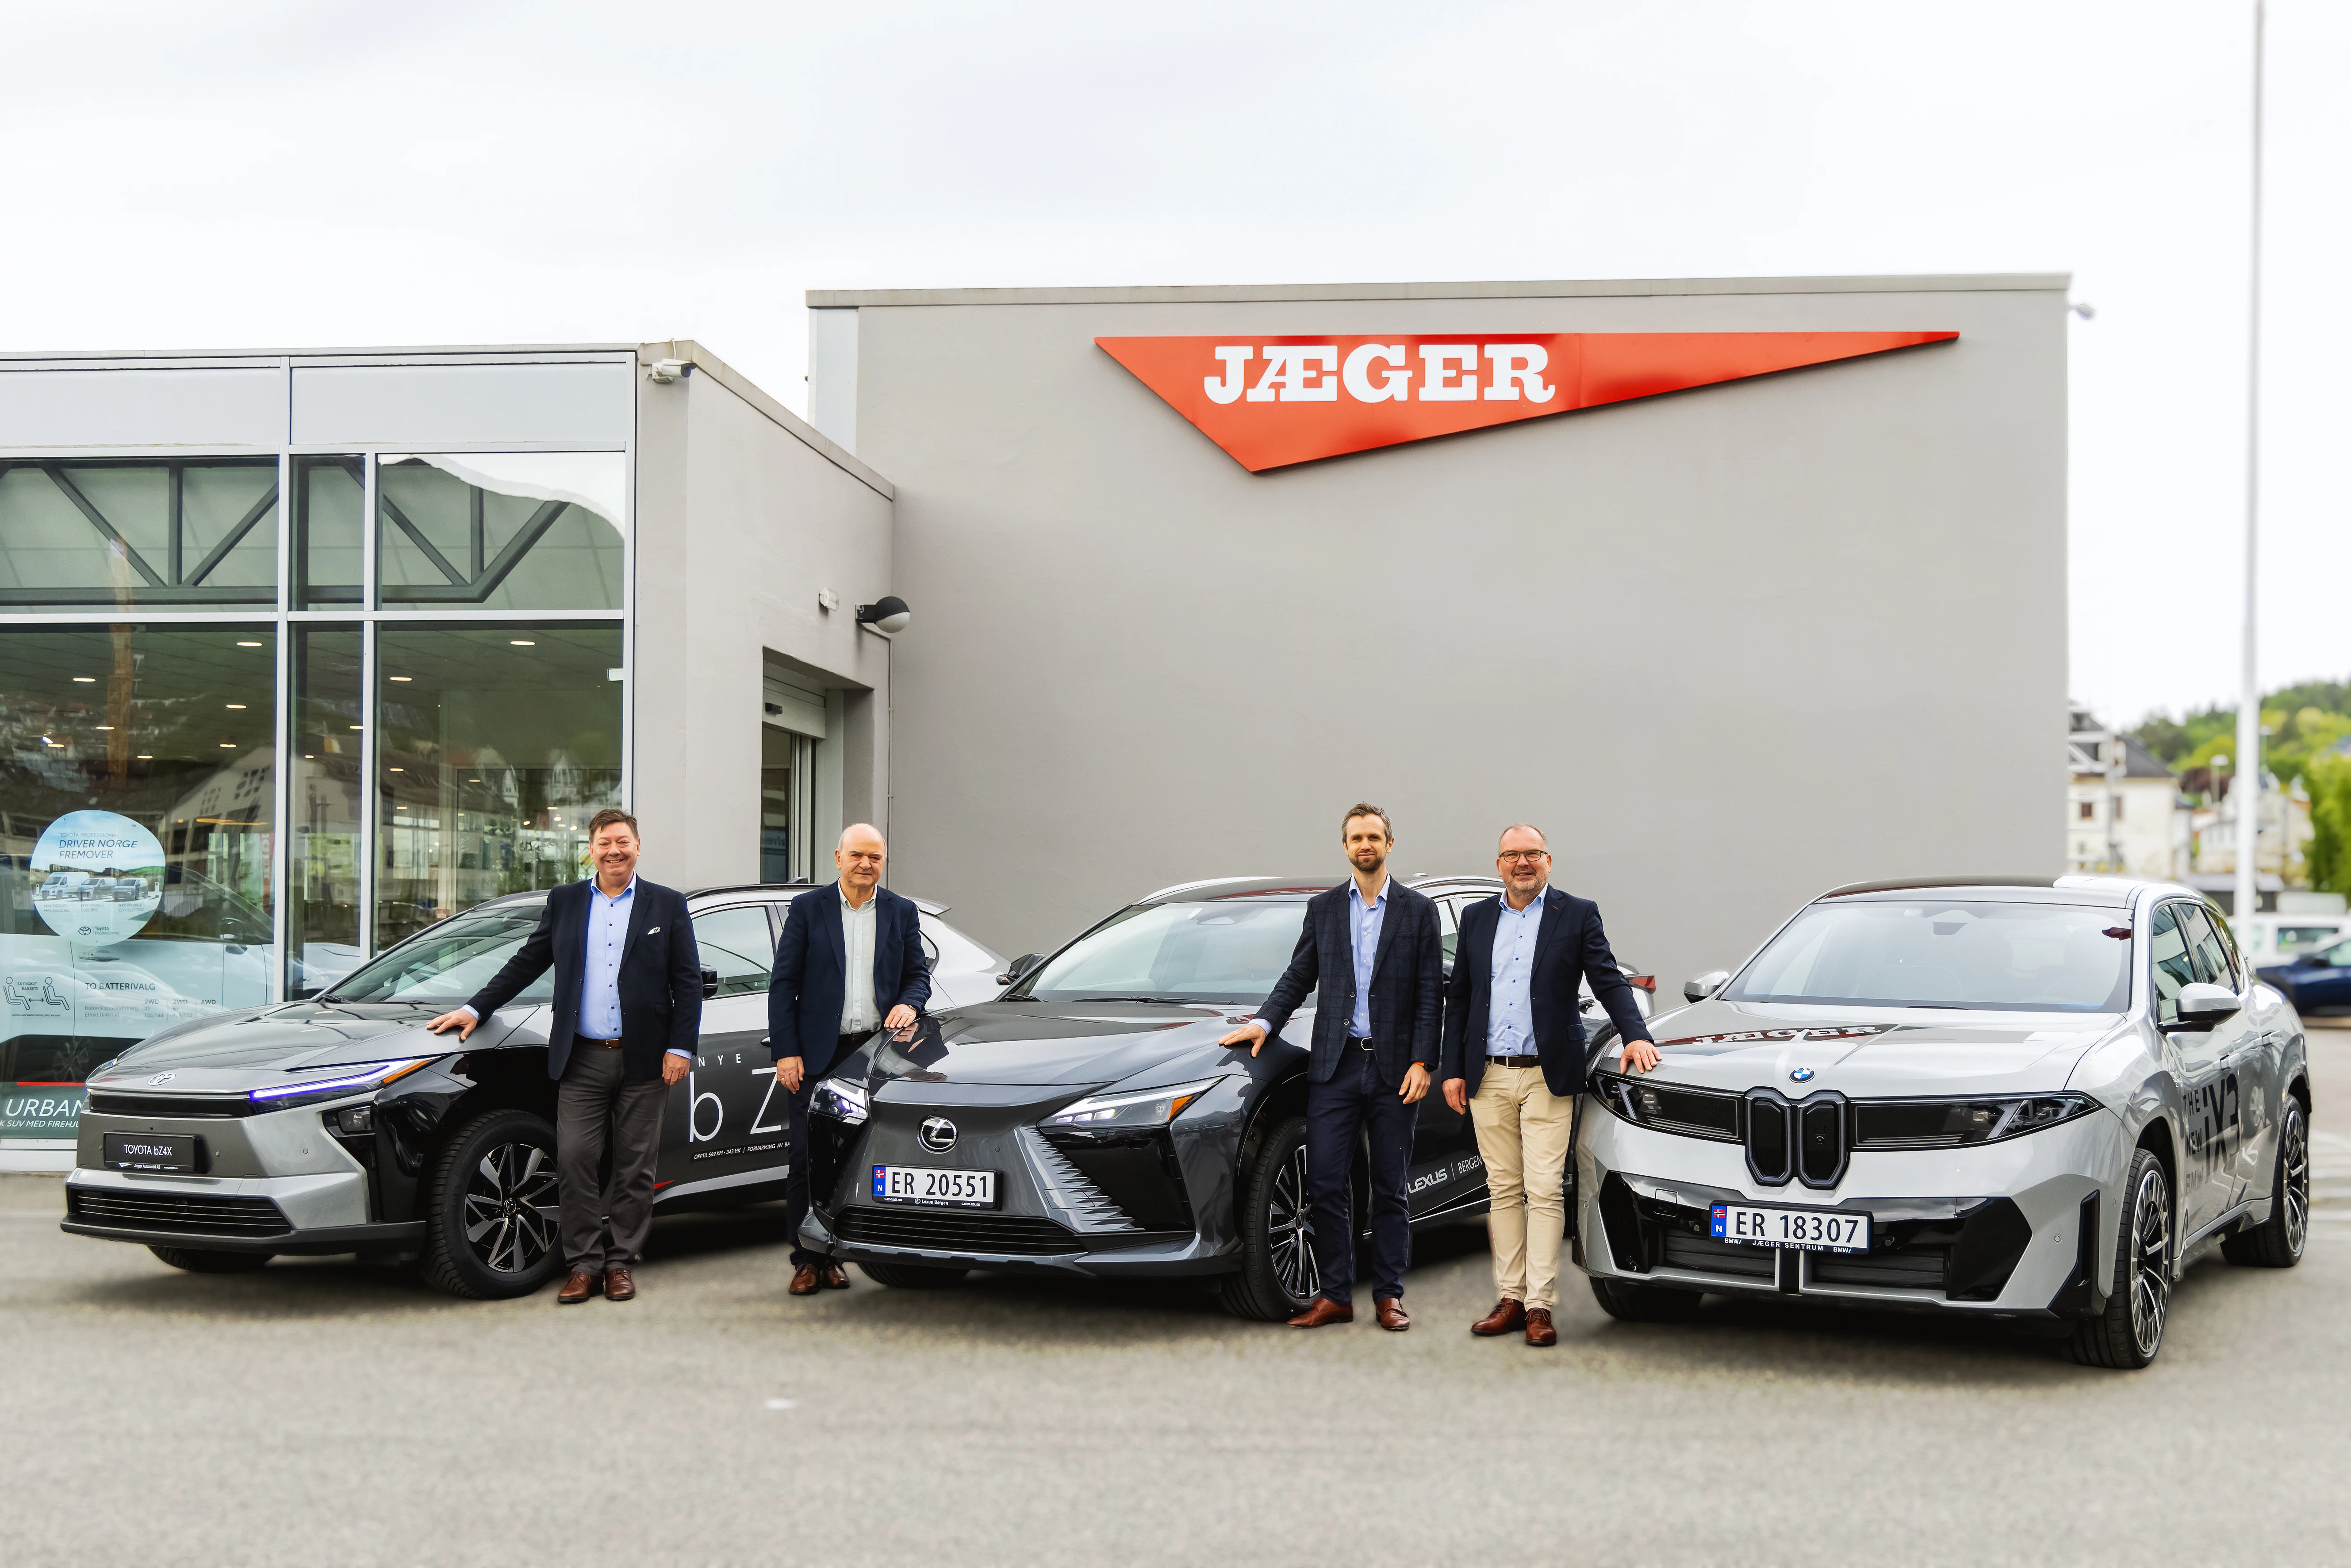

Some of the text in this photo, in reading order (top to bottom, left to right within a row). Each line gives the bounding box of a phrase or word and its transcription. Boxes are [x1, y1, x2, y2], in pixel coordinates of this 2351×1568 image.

[1204, 343, 1556, 404] JÆGER
[59, 840, 138, 848] DRIVER NORGE
[59, 850, 113, 859] FREMOVER
[698, 1053, 741, 1067] NYE
[2182, 1089, 2200, 1116] THE
[124, 1144, 173, 1156] TOYOTA bZ4X
[2186, 1127, 2202, 1158] NEW
[1458, 1154, 1483, 1174] BERGEN
[892, 1172, 986, 1198] ER 20551
[1407, 1168, 1447, 1193] LEXUS
[1736, 1211, 1859, 1243] ER 18307
[1784, 1242, 1824, 1251] SENTRUM
